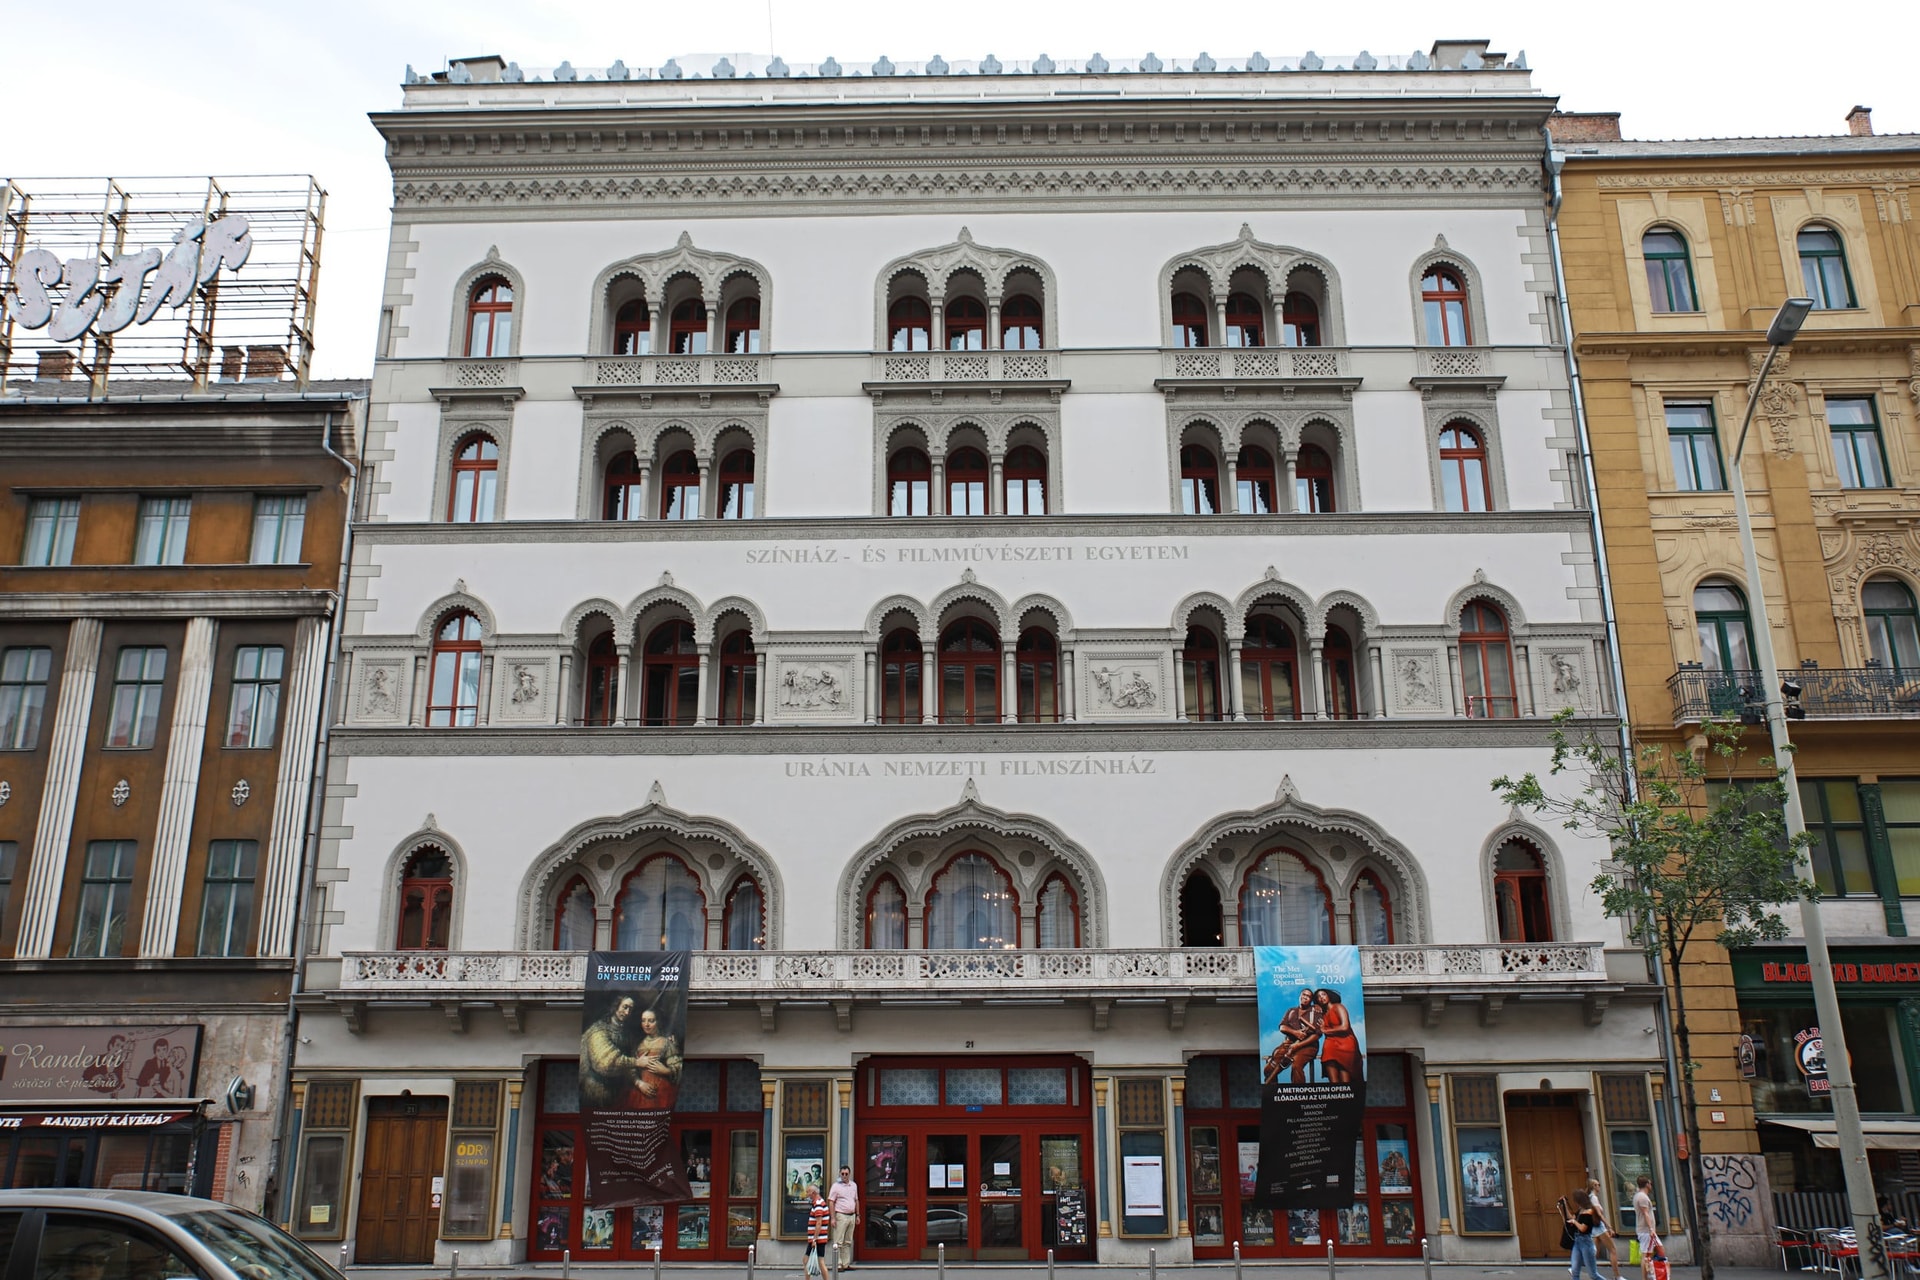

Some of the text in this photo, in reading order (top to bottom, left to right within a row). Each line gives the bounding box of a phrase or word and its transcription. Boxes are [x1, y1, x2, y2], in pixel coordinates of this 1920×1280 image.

[862, 544, 886, 563] ÉS
[899, 542, 1073, 562] FILMMŰVÉSZETI
[1085, 545, 1189, 560] EGYETEM
[785, 755, 1156, 777] URÁNIA NEMZETI FILMSZÍNHÁZ
[598, 965, 652, 974] EXHIBITION
[1315, 964, 1341, 974] 2019
[1831, 963, 1858, 982] AB
[1860, 962, 1920, 983] BURGE
[613, 973, 651, 981] SCREEN
[1273, 972, 1303, 981] ropolitan
[1320, 975, 1346, 985] 2020
[1273, 979, 1295, 987] Opera
[965, 1040, 974, 1048] 21
[11, 1043, 126, 1069] Randevú
[56, 1075, 70, 1088] &
[1282, 1086, 1330, 1094] METROPOLITAN
[1274, 1093, 1309, 1102] ELŐADÁSAI
[1318, 1092, 1354, 1100] URÁNIÁBAN
[40, 1113, 172, 1127] RANDEVÚ KÁVÉHÁZ
[456, 1142, 489, 1157] ÓDRY
